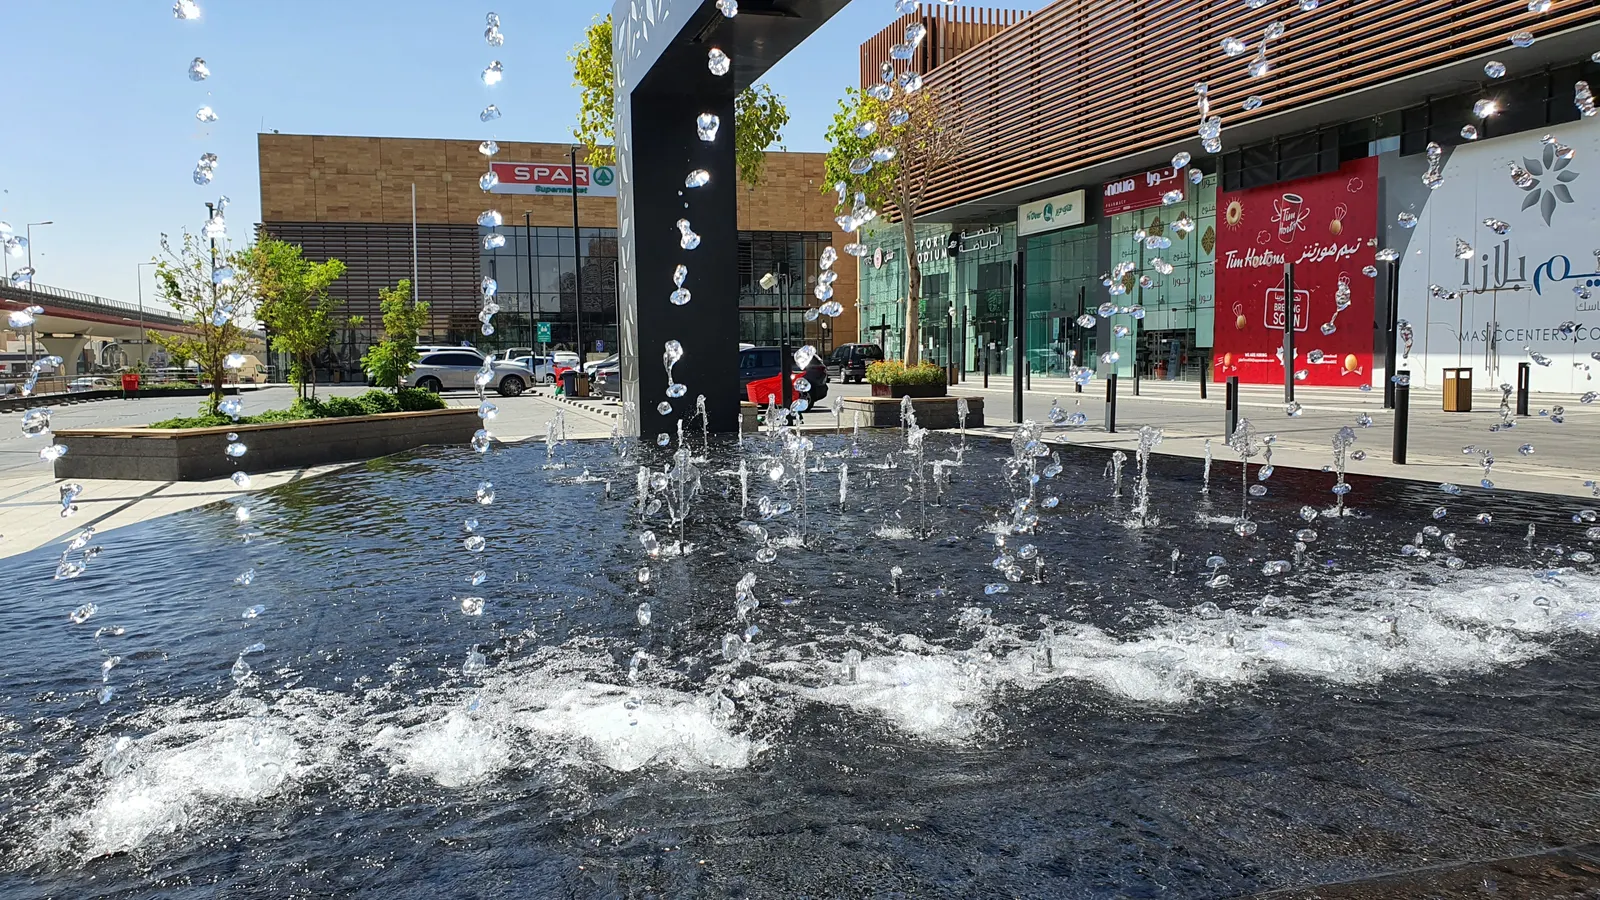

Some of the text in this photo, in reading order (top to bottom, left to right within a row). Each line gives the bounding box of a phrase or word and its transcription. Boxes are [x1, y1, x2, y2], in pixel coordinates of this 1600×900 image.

[514, 166, 588, 182] SPAR
[535, 185, 588, 194] Supermaket
[1282, 207, 1296, 221] Tim
[959, 235, 1002, 253] الرياضة
[1295, 237, 1362, 265] تيم هورتنز
[916, 248, 948, 264] ODIUM
[1225, 247, 1285, 269] Tim Hortons
[1273, 302, 1301, 314] BREG
[1575, 300, 1600, 312] اسك
[1272, 311, 1301, 328] SON
[1458, 326, 1600, 342] MASICCENTERS.CO
